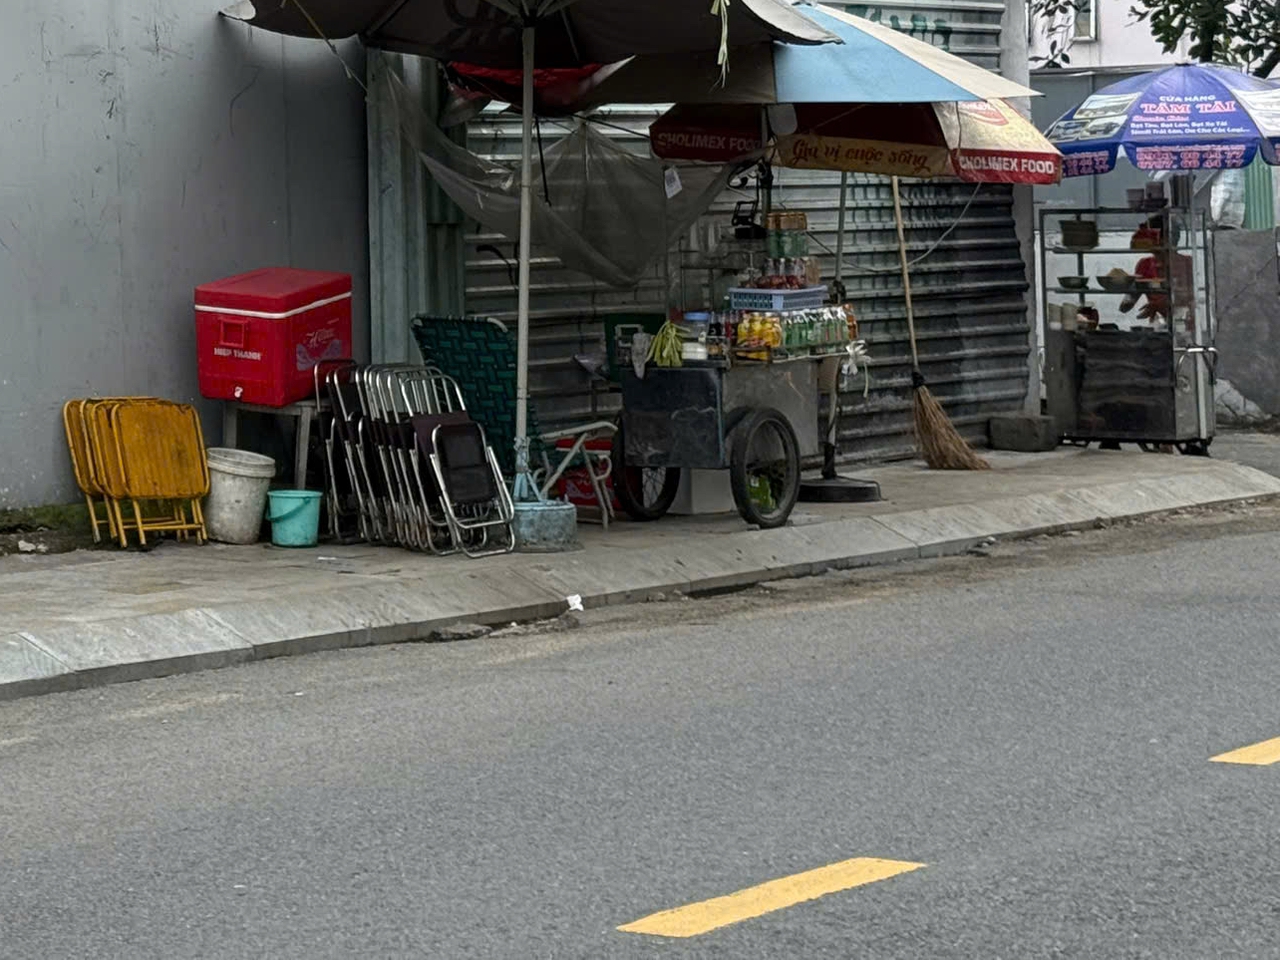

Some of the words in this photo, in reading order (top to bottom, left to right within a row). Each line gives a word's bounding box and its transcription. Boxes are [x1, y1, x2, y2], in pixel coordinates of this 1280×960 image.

[1140, 102, 1192, 115] TÂM
[792, 140, 818, 166] Gia
[824, 145, 841, 158] vị
[845, 147, 884, 164] cuộc
[888, 147, 931, 172] sống
[958, 155, 1018, 172] CHOLIMEX
[1020, 158, 1055, 174] FOOD
